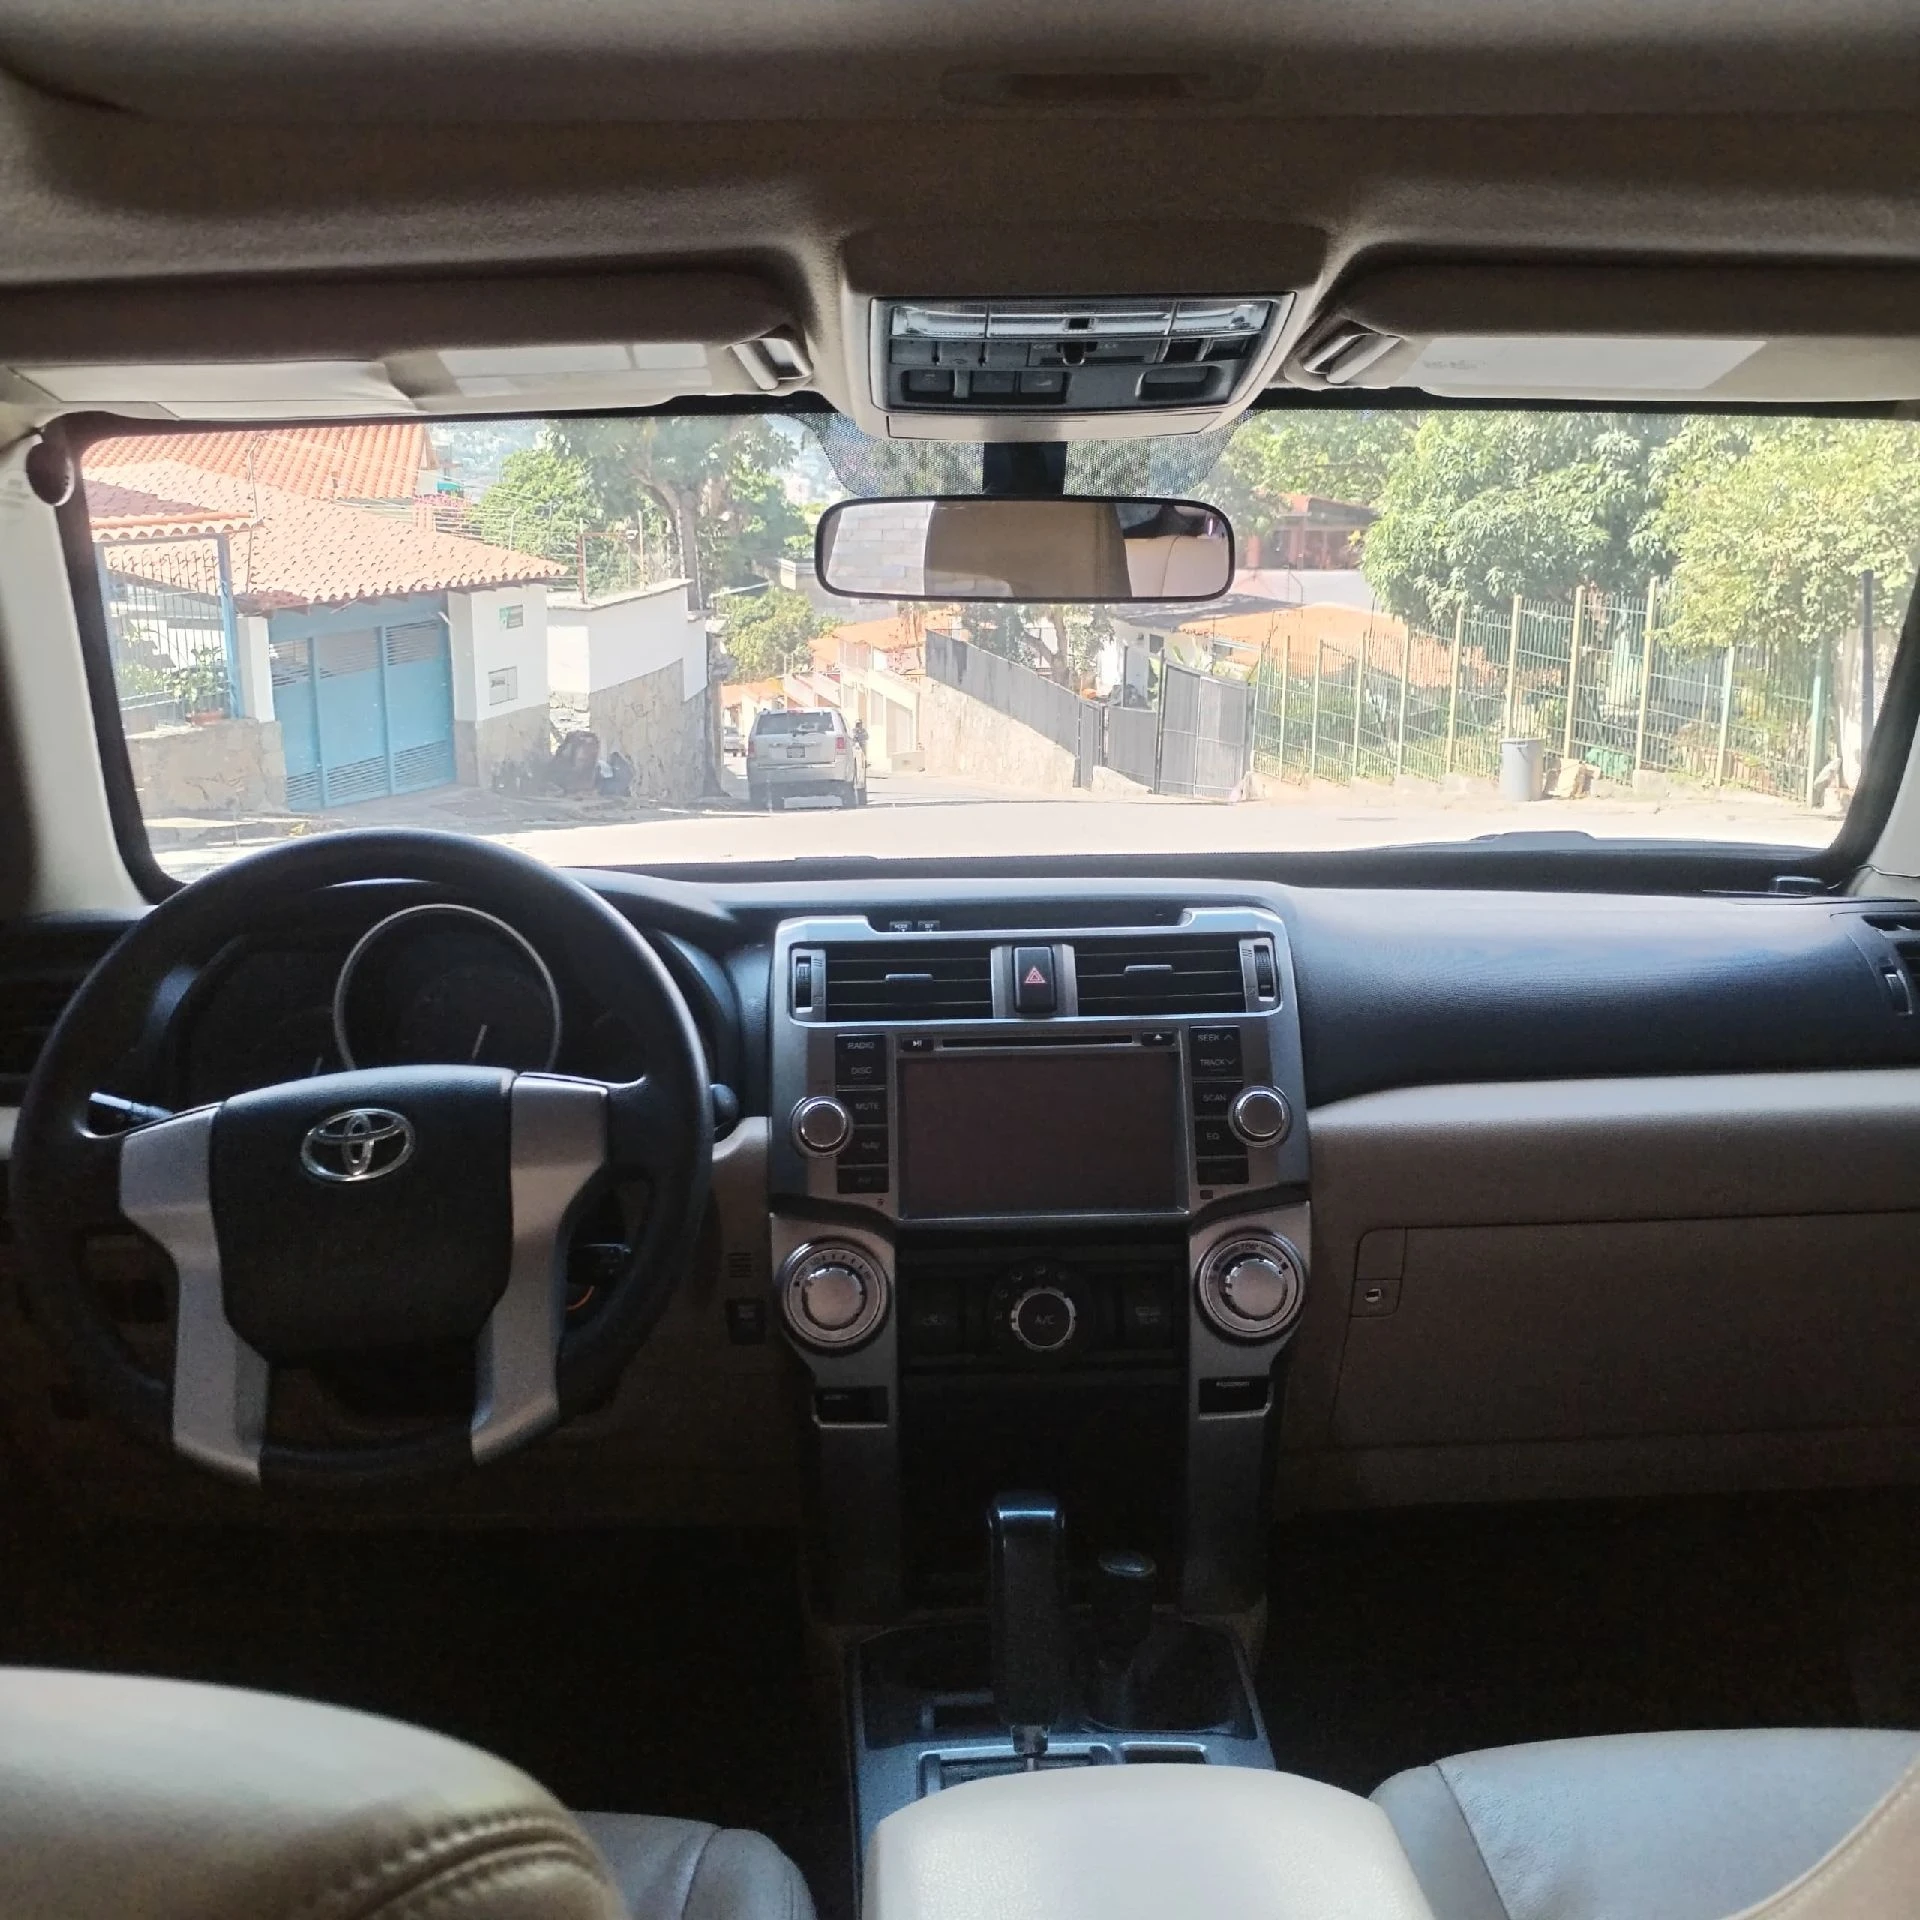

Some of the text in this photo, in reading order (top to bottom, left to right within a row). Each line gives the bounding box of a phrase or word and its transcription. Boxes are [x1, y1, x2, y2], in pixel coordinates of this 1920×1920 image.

[1197, 1033, 1220, 1042] SEEK
[847, 1041, 875, 1050] RADIO
[1199, 1058, 1225, 1067] TRACK
[850, 1066, 873, 1075] DISC
[1202, 1093, 1227, 1102] SCAN
[855, 1102, 881, 1111] MUTE
[1206, 1132, 1220, 1141] EQ
[1034, 1315, 1055, 1326] A/C
